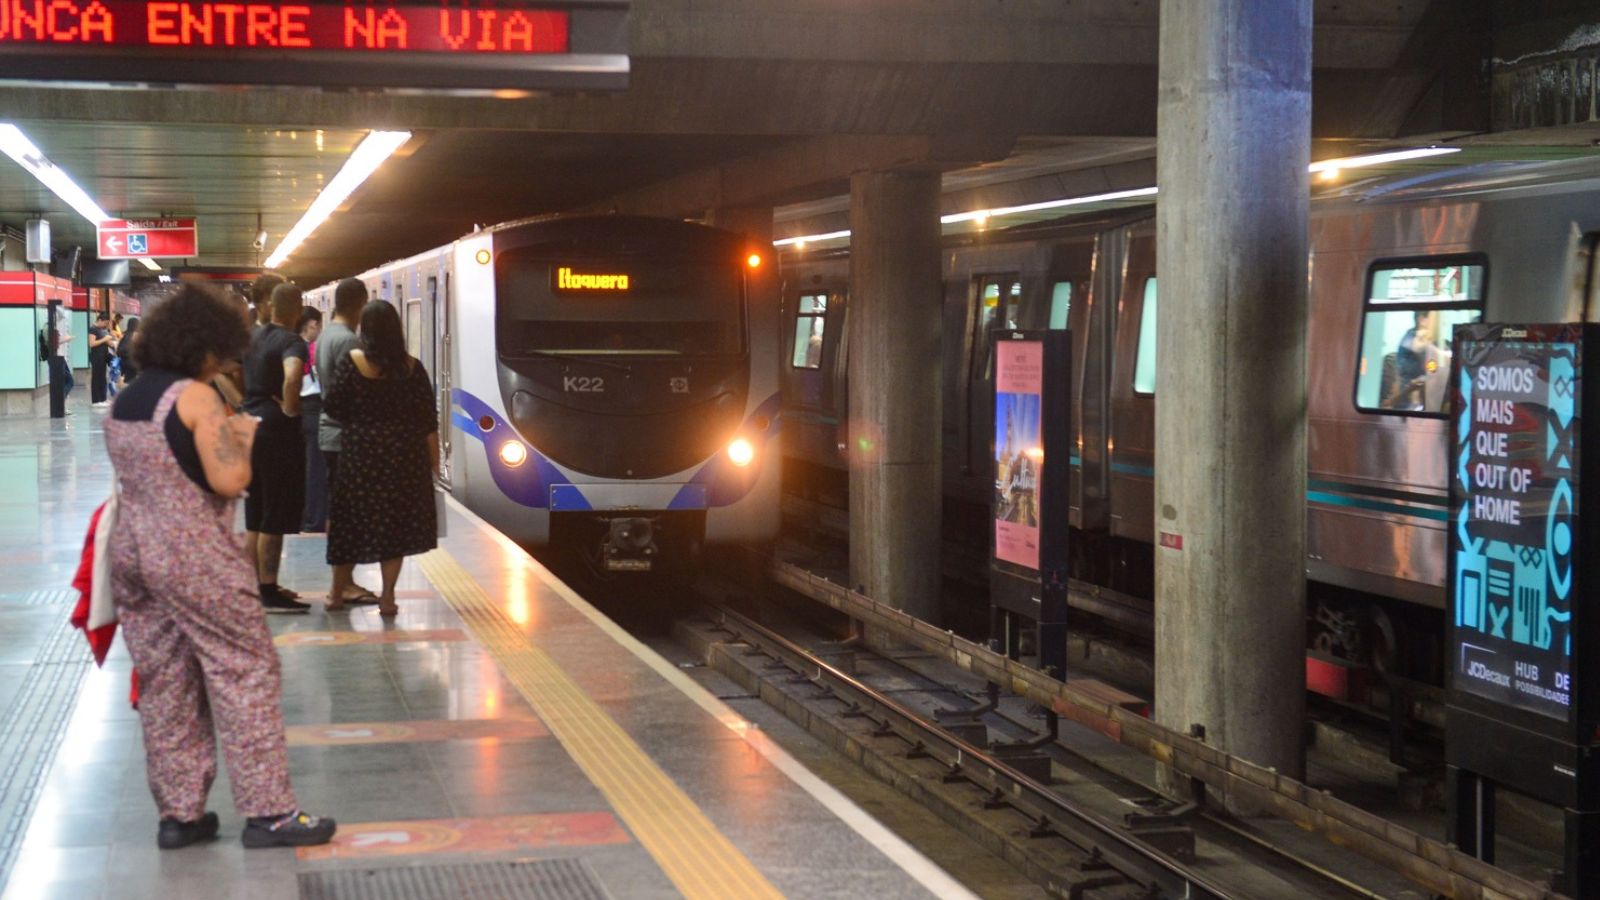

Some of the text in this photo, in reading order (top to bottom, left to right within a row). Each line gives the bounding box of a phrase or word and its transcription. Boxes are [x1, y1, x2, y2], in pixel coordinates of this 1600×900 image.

[147, 3, 312, 47] ENTRE
[344, 7, 407, 49] NA
[439, 9, 533, 51] VIA
[563, 376, 604, 392] K22
[1477, 365, 1534, 394] SOMOS
[1476, 398, 1514, 425] MAIS
[1476, 430, 1508, 458] QUE
[1475, 462, 1532, 493] OUT OF
[1475, 494, 1520, 525] HOME
[1467, 660, 1511, 689] JCDecaux
[1515, 661, 1570, 691] HUB DE
